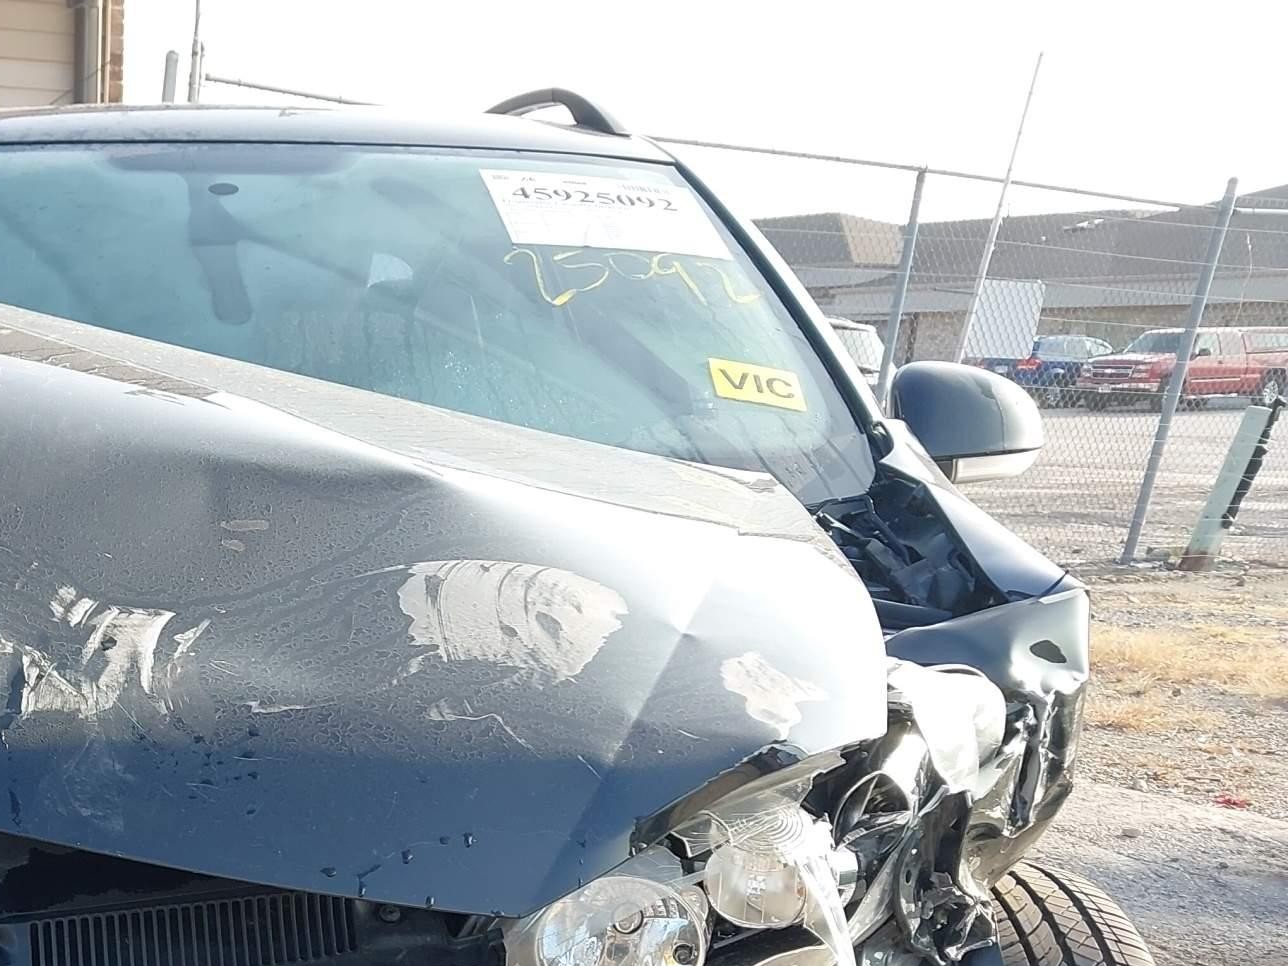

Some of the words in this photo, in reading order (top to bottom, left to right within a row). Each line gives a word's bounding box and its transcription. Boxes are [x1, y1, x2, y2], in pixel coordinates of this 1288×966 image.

[512, 186, 678, 212] 45925092
[503, 247, 761, 306] 25092
[719, 367, 796, 400] VIC
